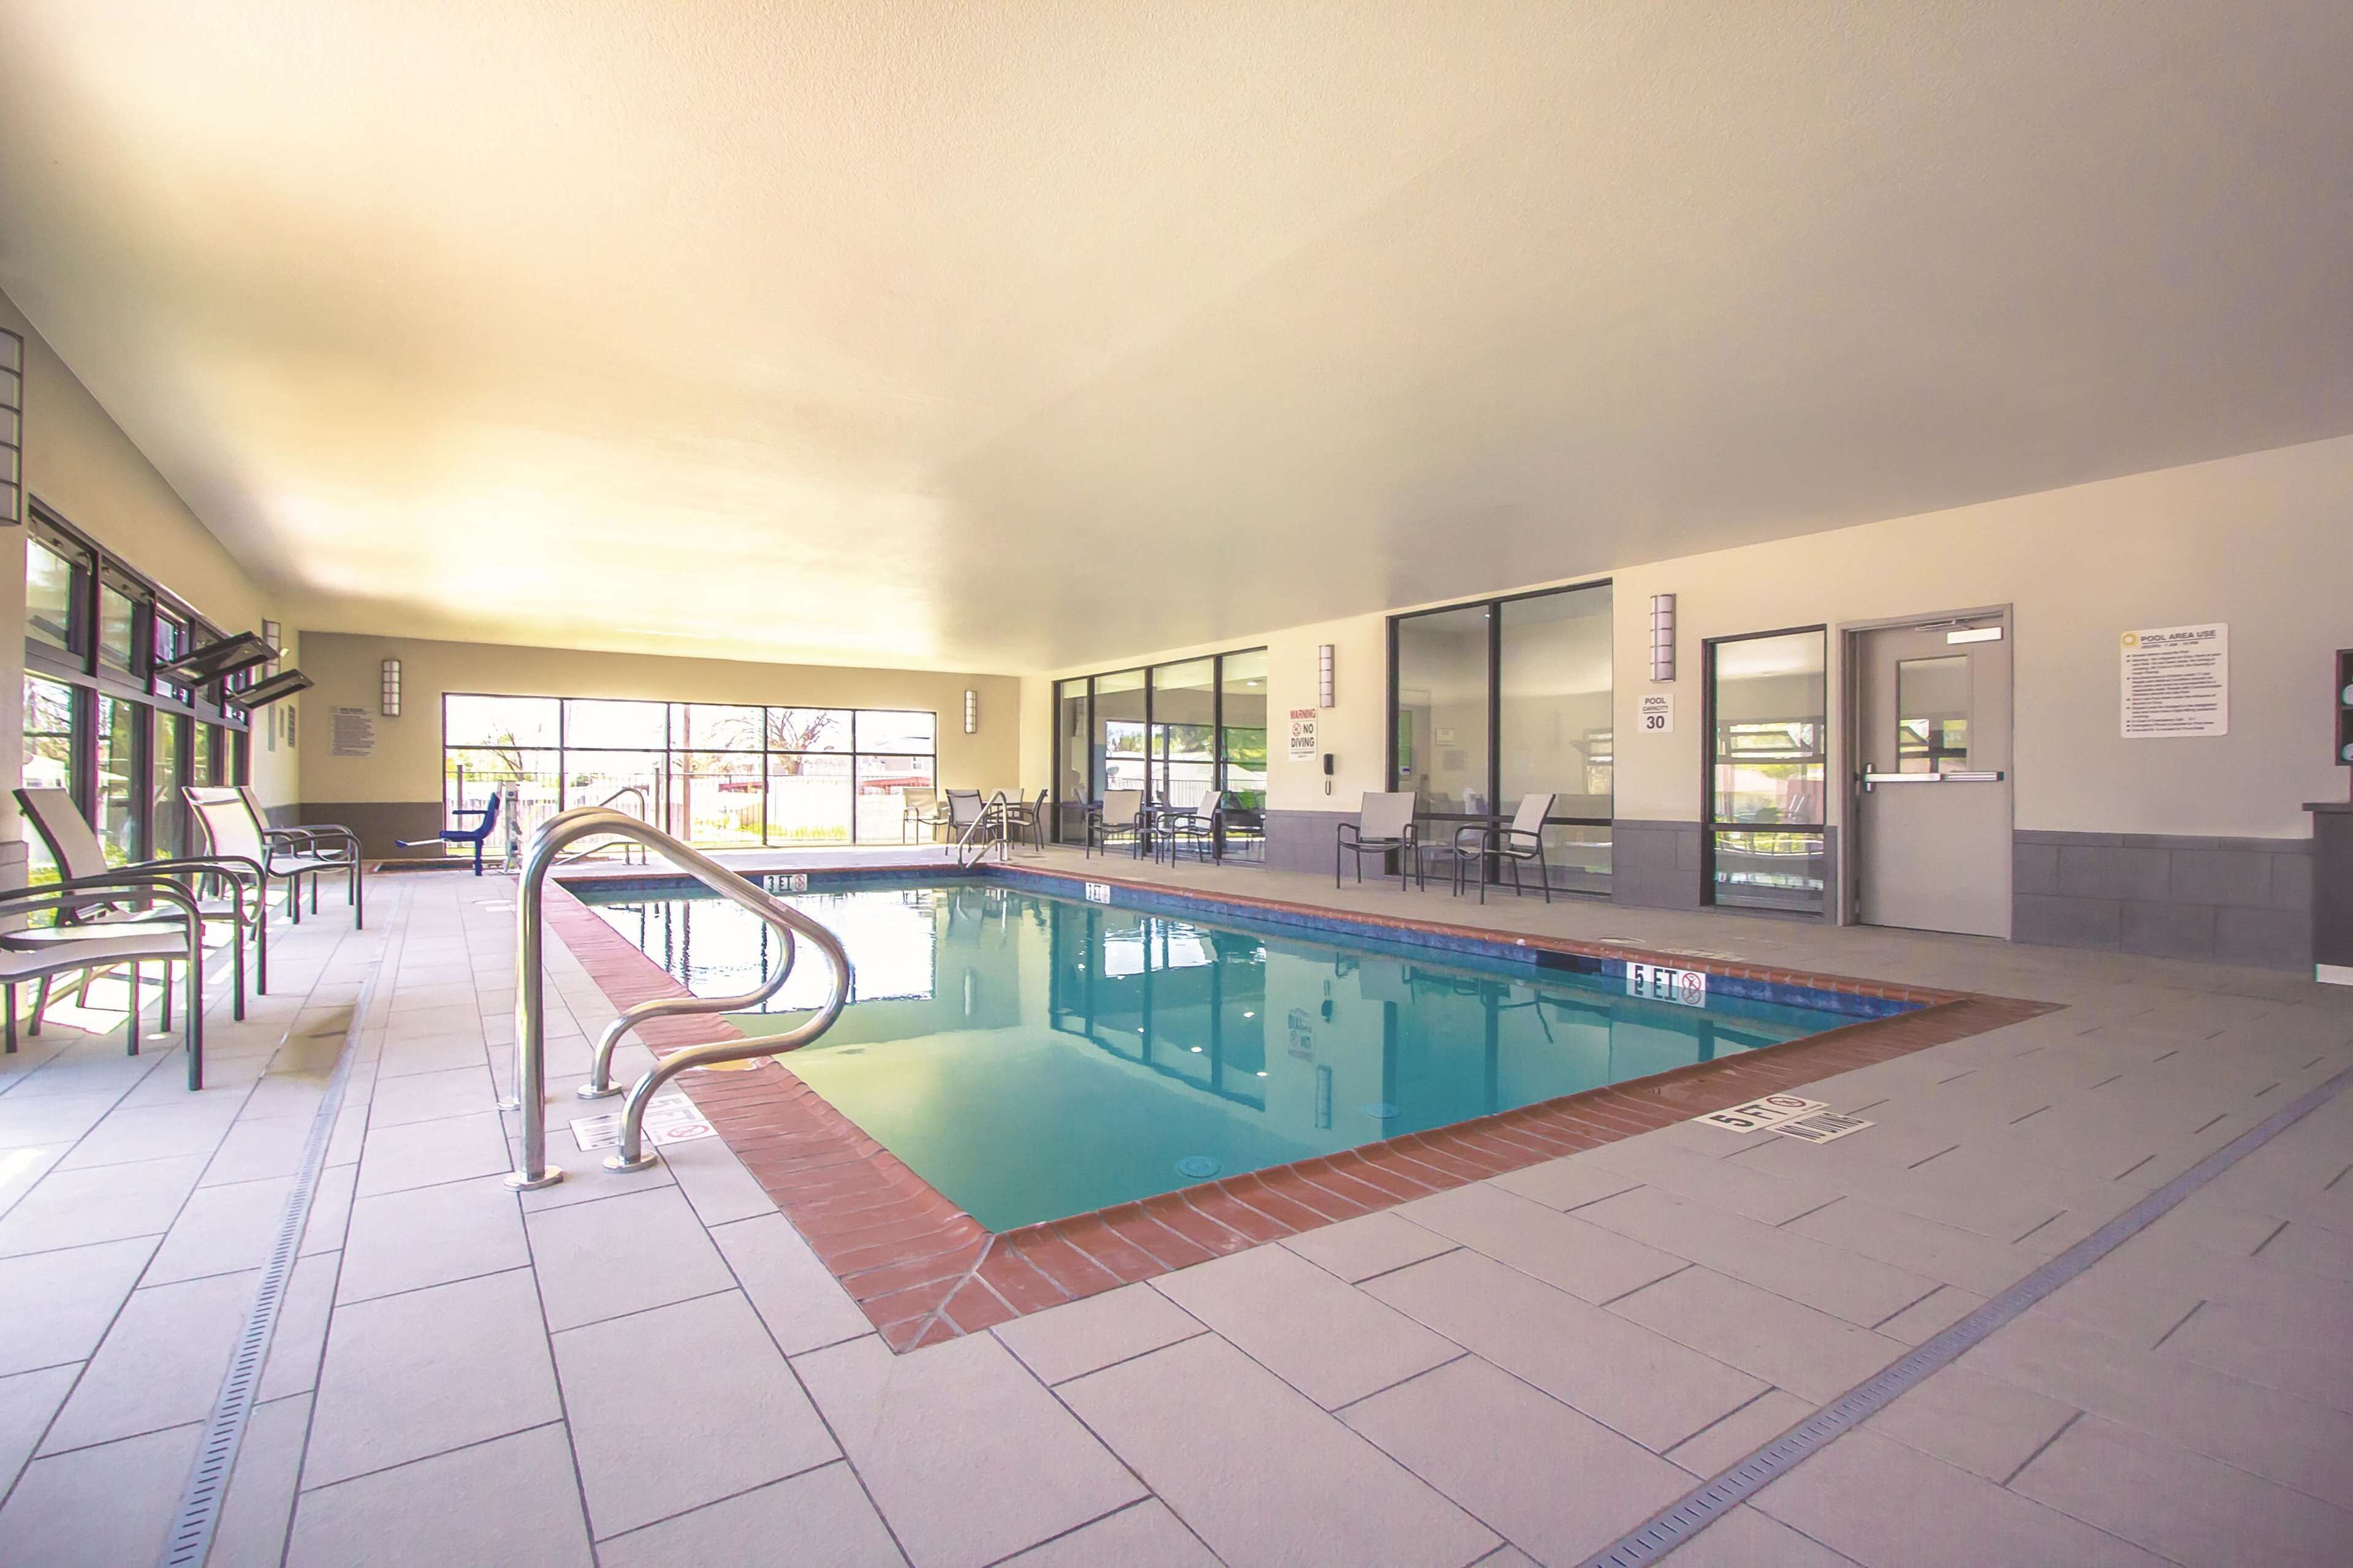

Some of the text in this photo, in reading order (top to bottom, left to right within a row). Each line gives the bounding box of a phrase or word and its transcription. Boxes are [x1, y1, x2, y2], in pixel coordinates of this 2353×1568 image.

[1290, 709, 1315, 719] WARNING
[1303, 724, 1313, 733] NO
[1646, 716, 1665, 729] 30
[1291, 737, 1315, 748] DIVING
[1708, 1115, 1754, 1127] 5
[1734, 1104, 1788, 1120] FT
[1775, 1113, 1865, 1140] NO DIVING
